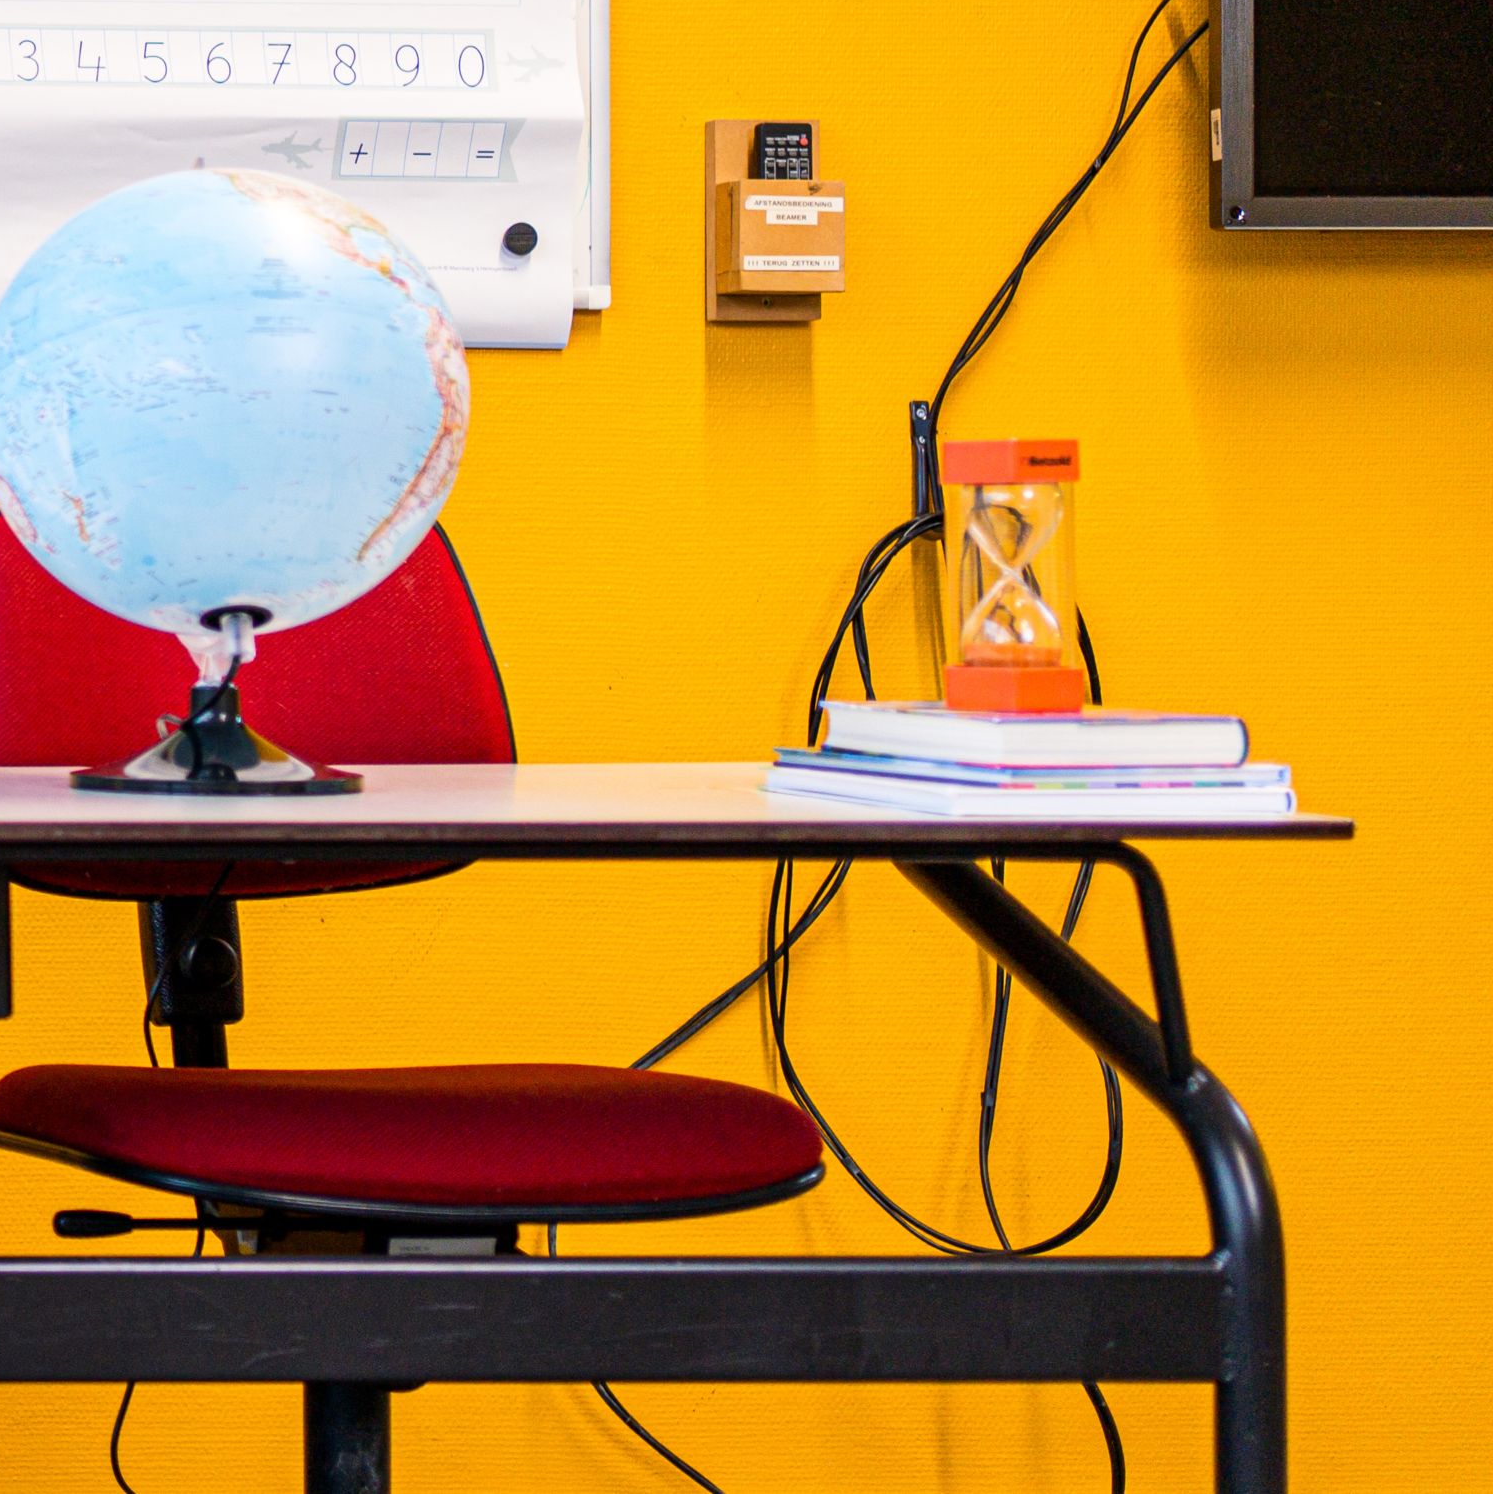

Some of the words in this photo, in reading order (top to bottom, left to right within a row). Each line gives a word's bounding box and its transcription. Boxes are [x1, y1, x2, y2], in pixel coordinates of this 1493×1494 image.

[17, 39, 40, 82] 3
[77, 40, 106, 83] 4
[143, 41, 168, 84] 5
[206, 42, 232, 85] 6
[267, 42, 292, 85] 7
[333, 43, 357, 87] 8
[395, 44, 420, 87] 9
[458, 45, 485, 88] 0
[754, 199, 833, 208] AFSTANDSBEDIENING
